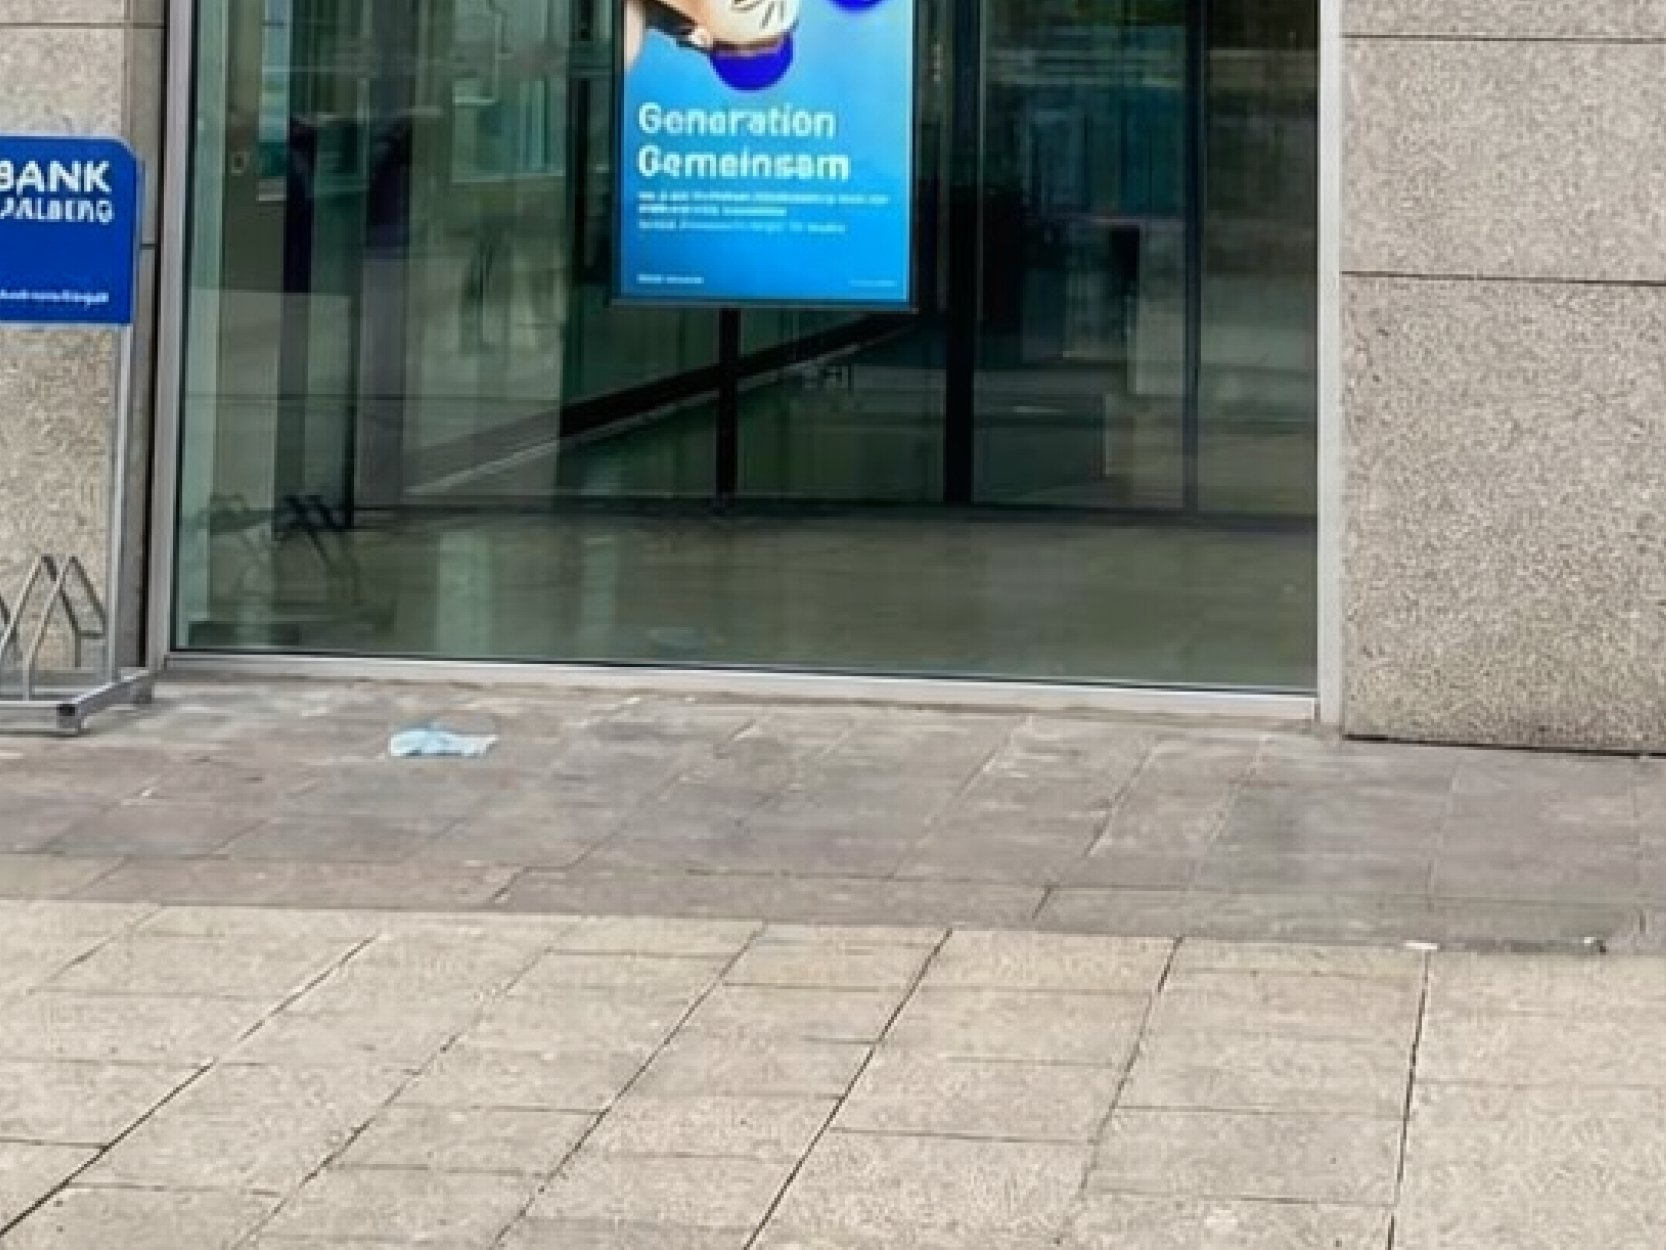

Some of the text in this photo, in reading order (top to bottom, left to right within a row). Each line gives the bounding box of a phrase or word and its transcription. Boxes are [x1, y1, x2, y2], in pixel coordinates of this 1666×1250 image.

[638, 101, 837, 138] Generation
[0, 160, 112, 195] BANK
[638, 144, 851, 181] Gemeinsam
